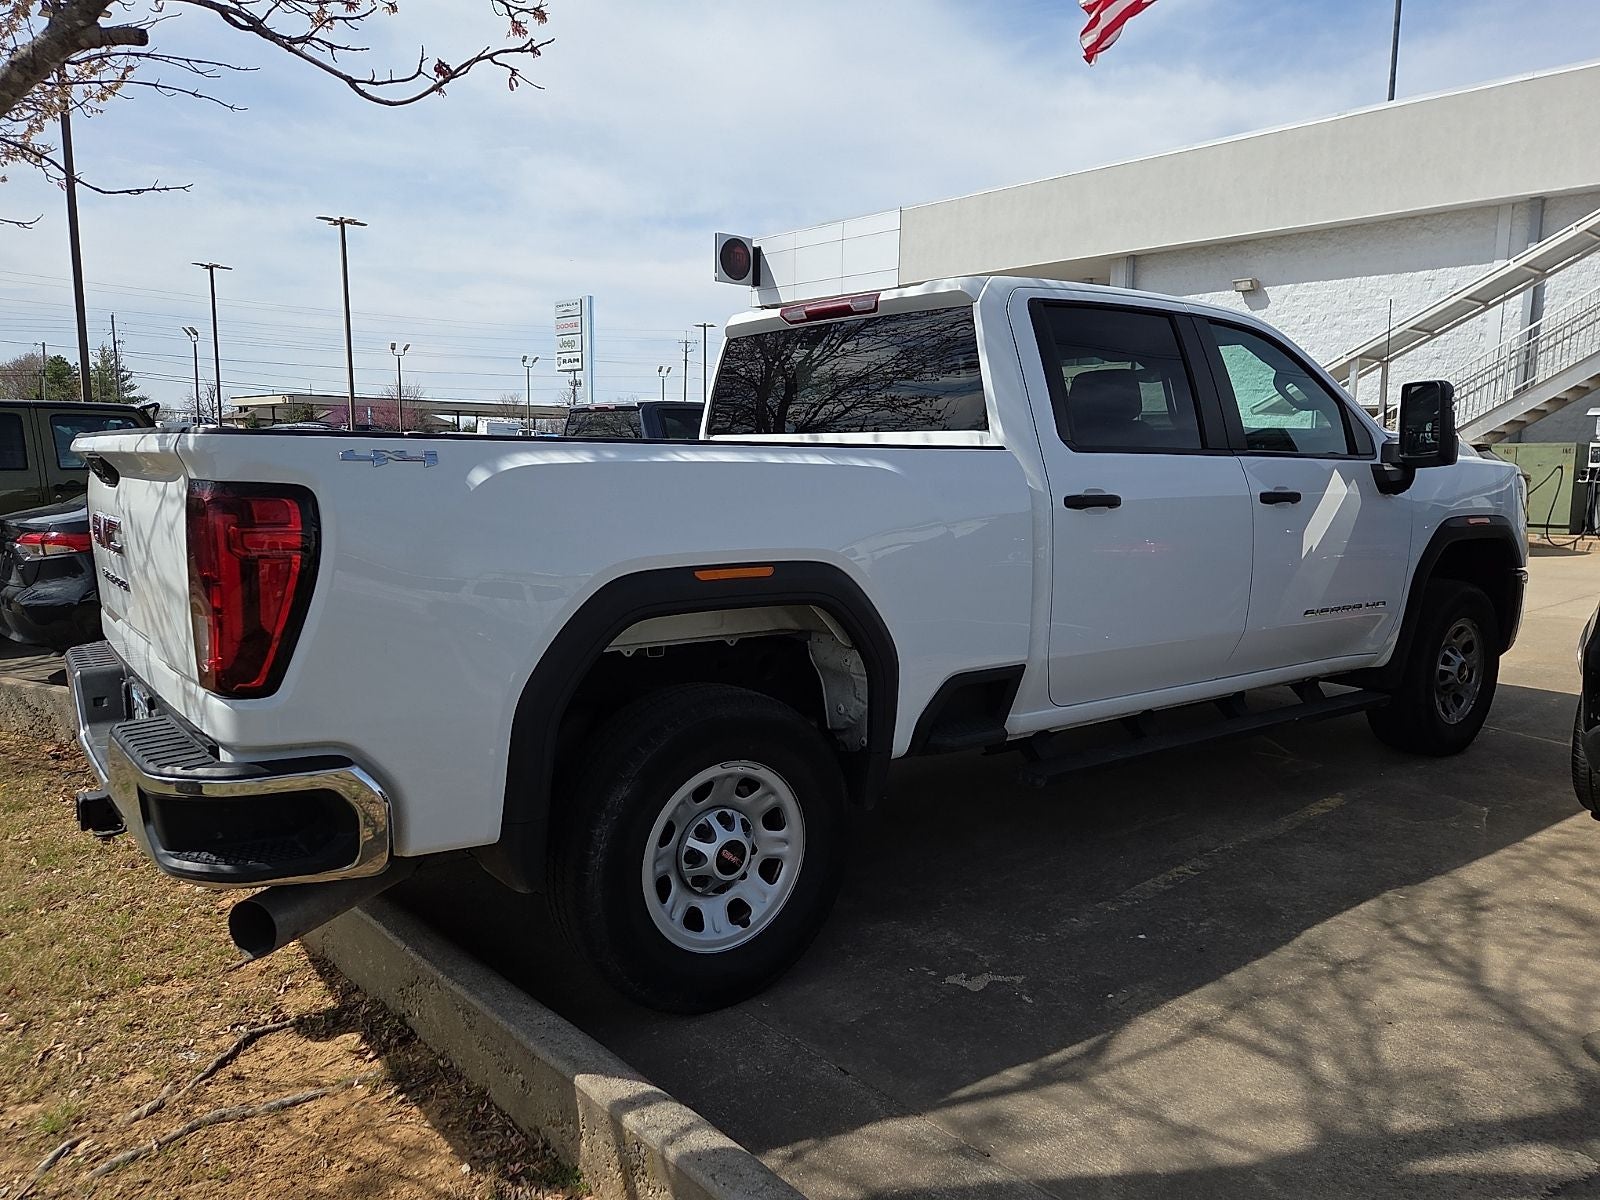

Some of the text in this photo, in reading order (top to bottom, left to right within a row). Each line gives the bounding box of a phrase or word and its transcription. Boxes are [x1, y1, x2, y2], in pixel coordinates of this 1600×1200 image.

[556, 322, 579, 330] DODGE
[559, 338, 576, 350] Jeep
[562, 357, 580, 365] RAM
[1303, 601, 1387, 617] SIERRA HD
[721, 849, 743, 867] GMC
